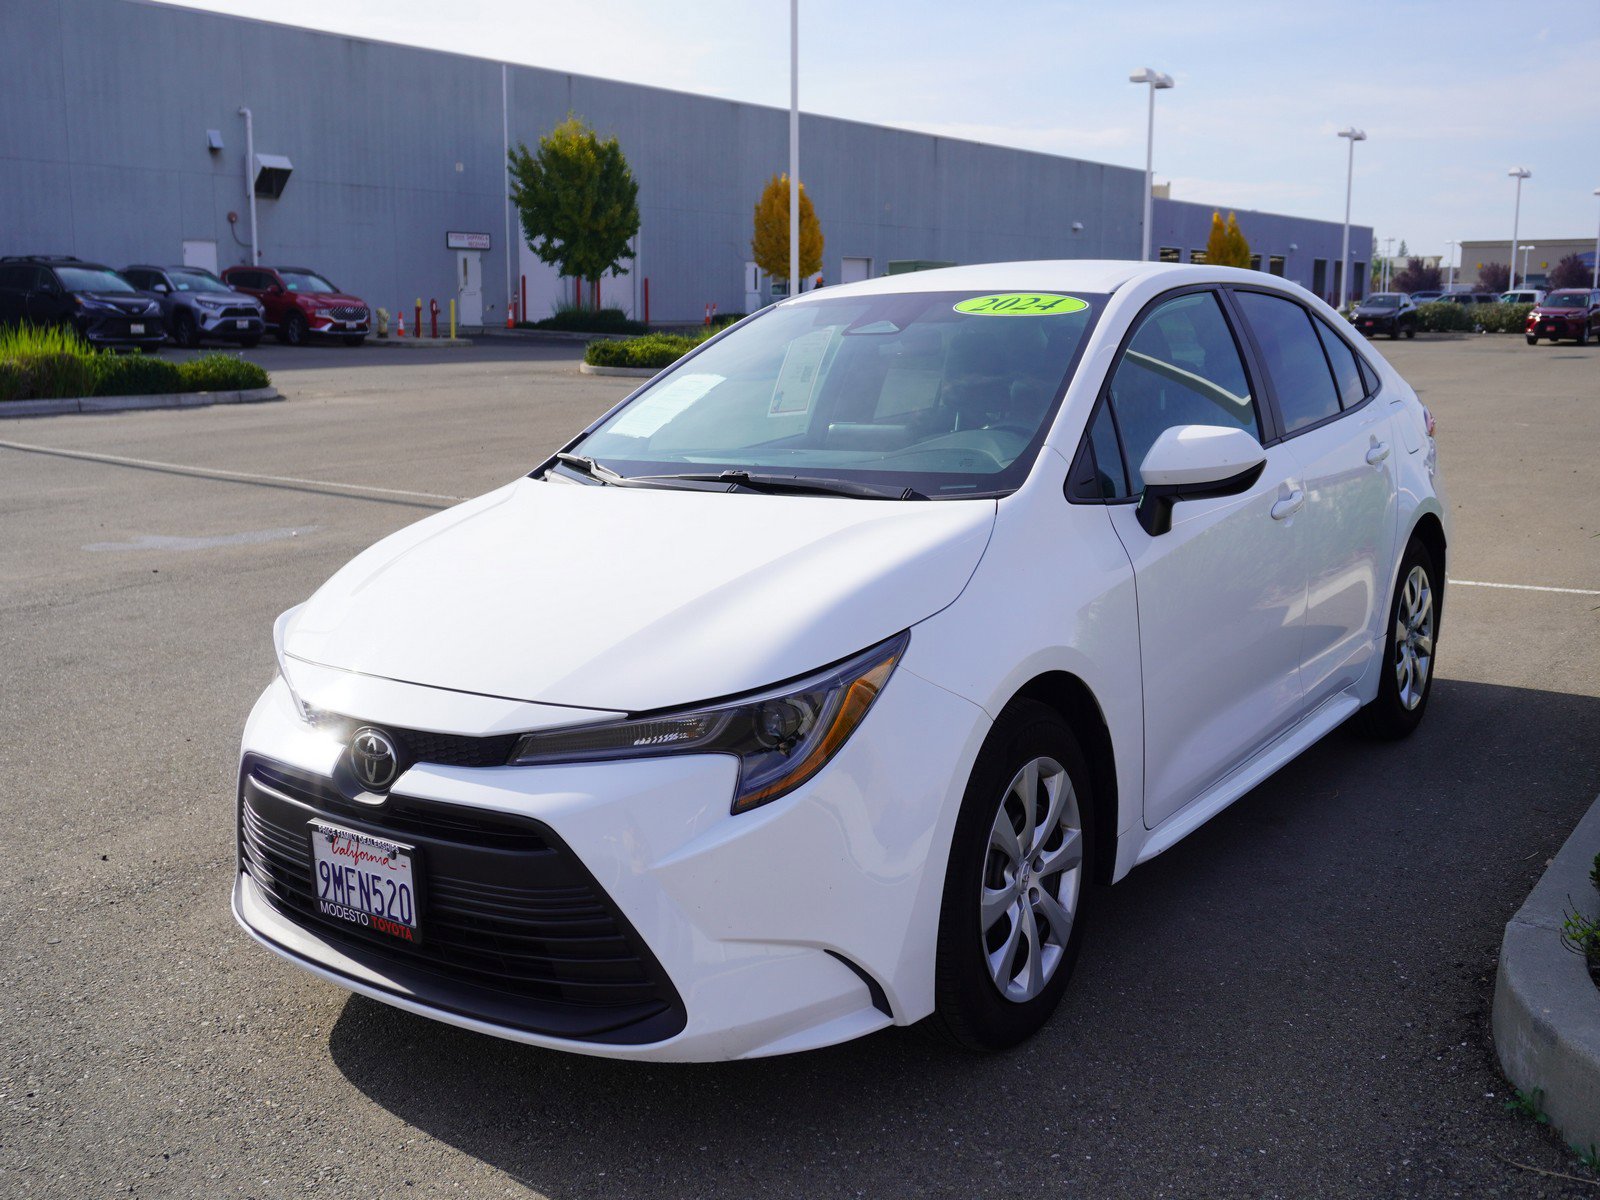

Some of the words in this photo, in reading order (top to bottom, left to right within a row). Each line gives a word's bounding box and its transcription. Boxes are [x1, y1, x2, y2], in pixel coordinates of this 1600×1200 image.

[968, 297, 1067, 311] 2024
[332, 836, 397, 870] California
[319, 860, 412, 926] 9MFN520
[320, 901, 369, 926] MODESTO
[371, 916, 413, 941] TOYOTA
